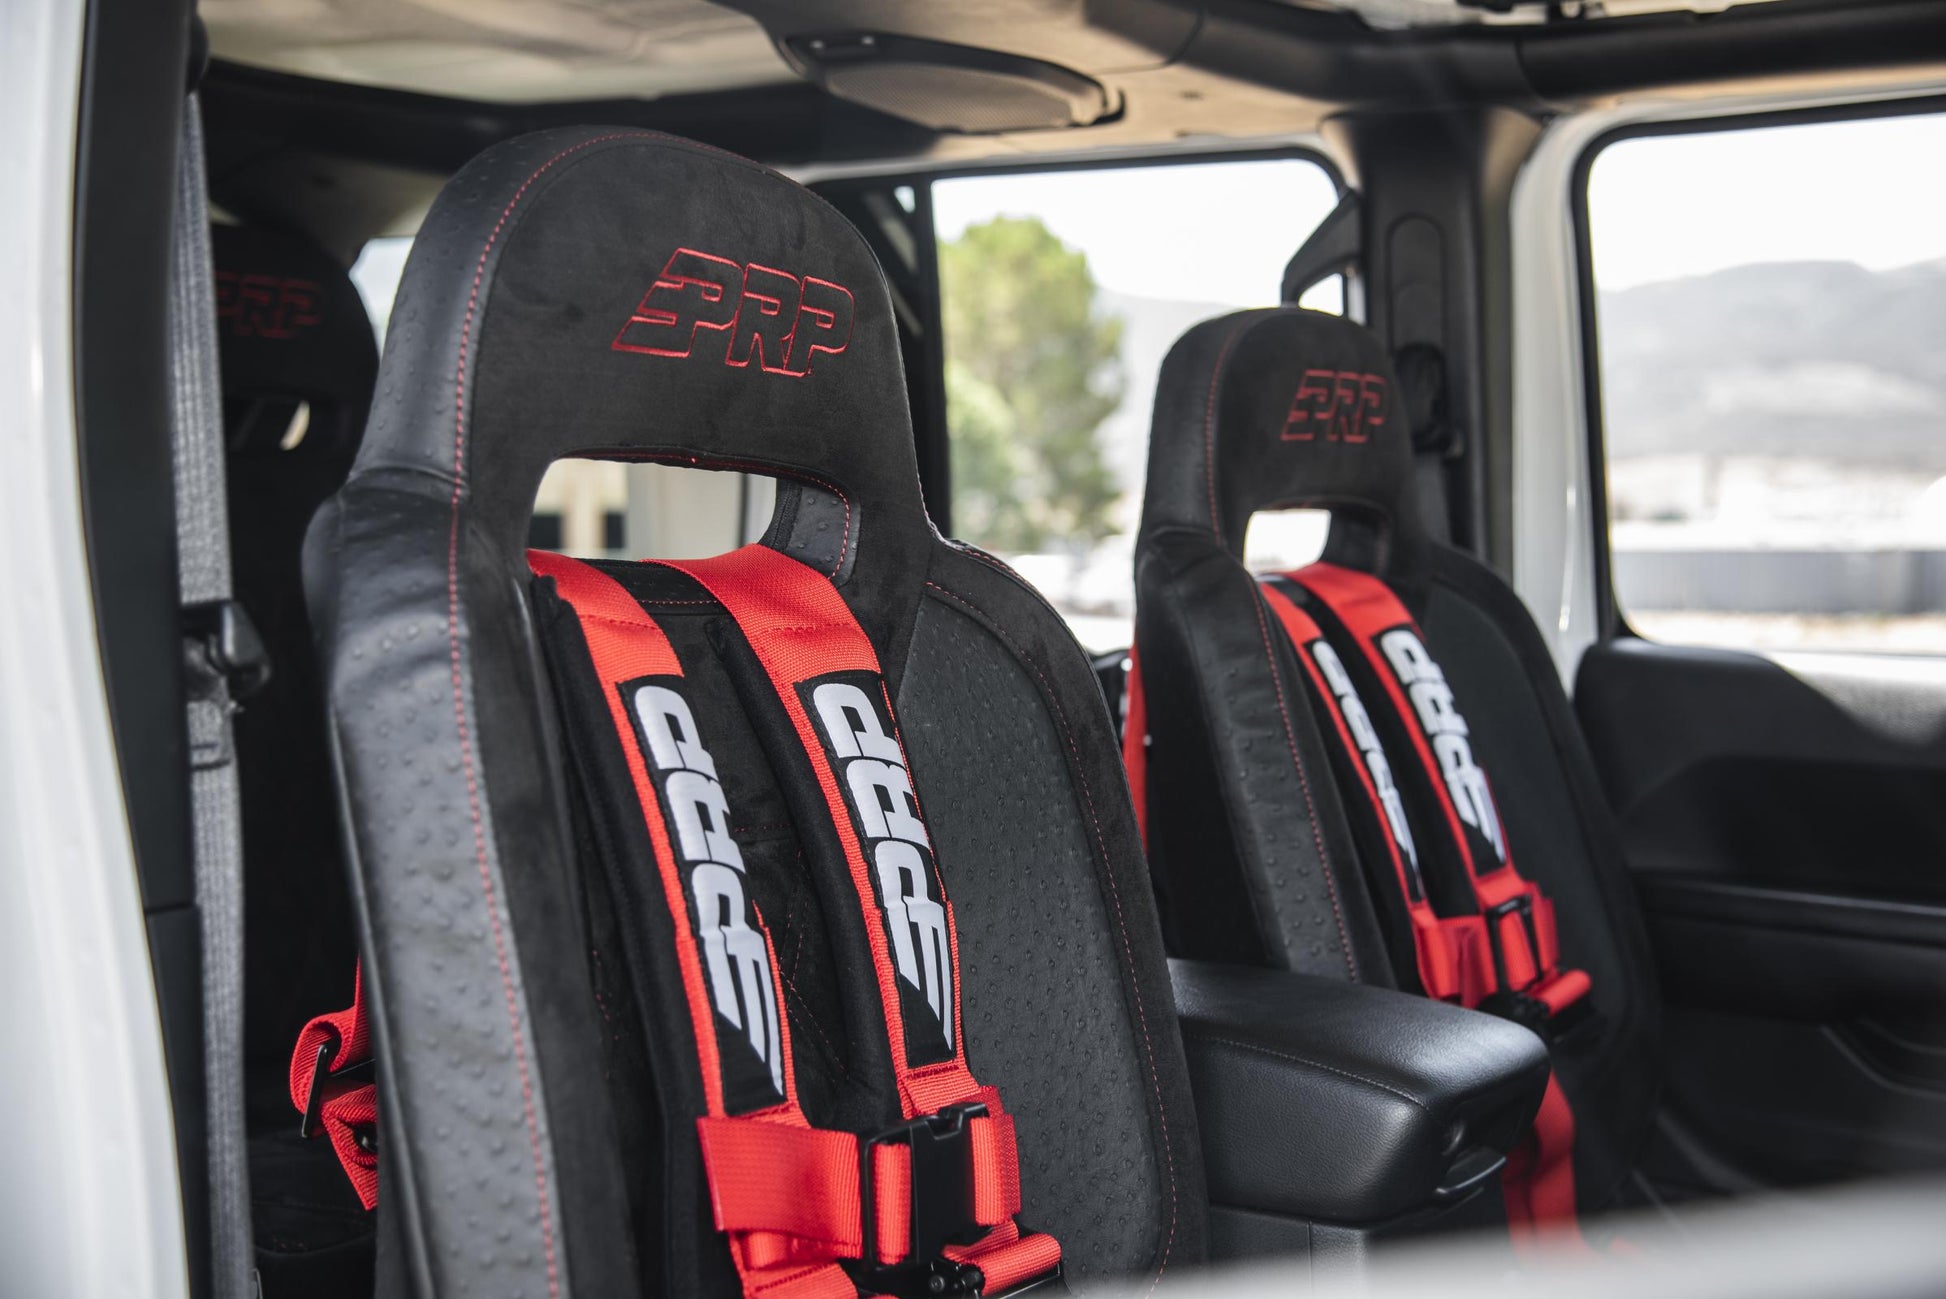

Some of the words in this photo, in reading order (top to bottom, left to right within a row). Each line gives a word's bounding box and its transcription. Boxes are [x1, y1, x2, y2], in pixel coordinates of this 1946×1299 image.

[611, 247, 855, 378] PRP
[1280, 369, 1389, 443] PRP
[634, 685, 783, 1096] PRP
[812, 682, 951, 1051] PRP
